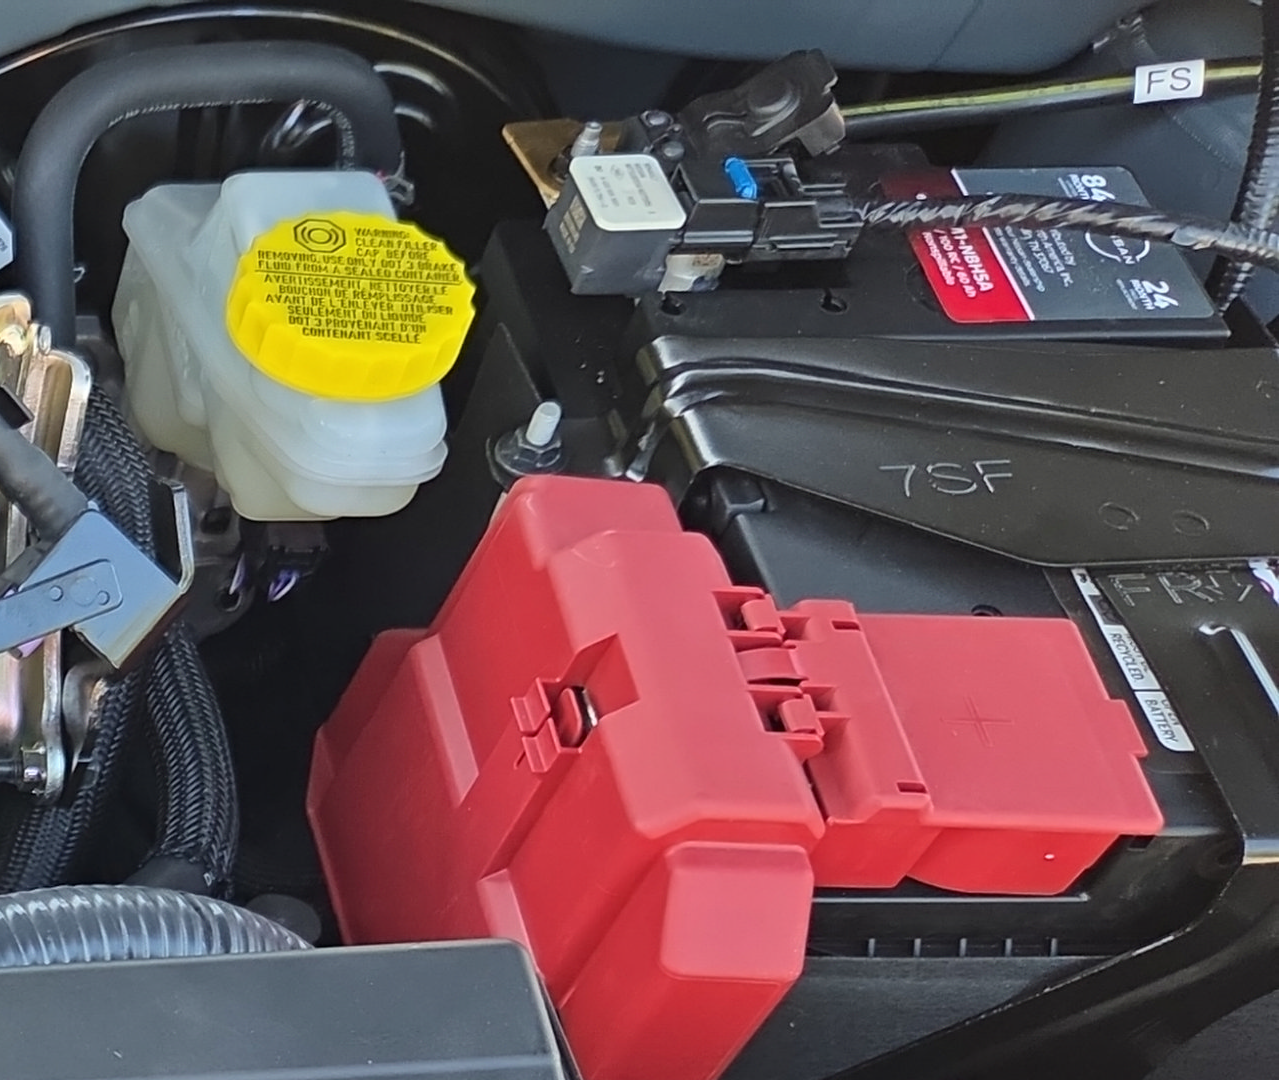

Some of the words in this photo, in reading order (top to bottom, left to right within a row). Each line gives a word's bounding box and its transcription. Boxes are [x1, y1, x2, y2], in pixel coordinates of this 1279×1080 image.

[1147, 67, 1192, 95] FS
[1081, 174, 1116, 202] 84
[355, 237, 394, 249] CLEAN
[396, 240, 438, 251] FILLER
[356, 247, 379, 257] CAP
[386, 249, 430, 260] BEFORE
[258, 260, 291, 270] FLUID
[296, 263, 329, 274] FROM
[332, 265, 340, 275] A
[344, 266, 392, 278] SEALED
[323, 255, 345, 265] USE
[346, 257, 376, 268] ONLY
[381, 260, 402, 269] DOT
[406, 260, 414, 270] 3
[417, 261, 457, 272] BRAKE
[278, 285, 331, 297] BOUCHON
[1141, 280, 1179, 309] 24
[265, 294, 306, 306] AVANT
[310, 296, 325, 307] DE
[287, 305, 357, 319] SEULEMENT
[361, 310, 377, 320] DU
[380, 312, 424, 323] LIQUIDE
[288, 315, 310, 327] DOT
[314, 317, 322, 327] 3
[325, 317, 395, 332] PROVENANT
[399, 322, 427, 333] D'UN
[302, 326, 371, 341] CONTENANT
